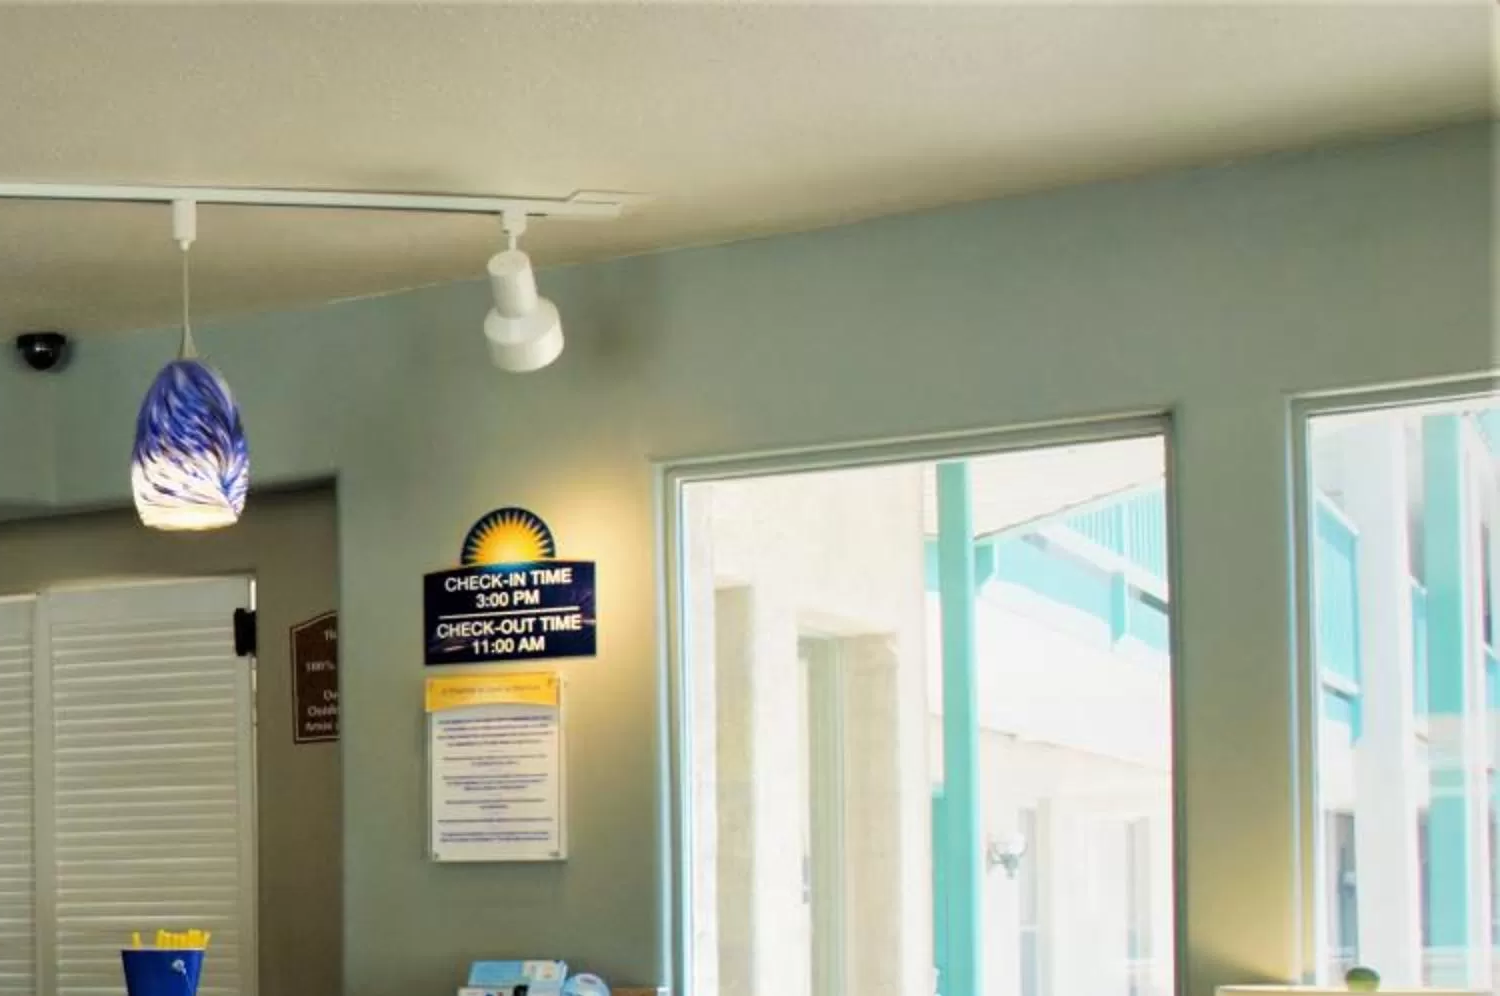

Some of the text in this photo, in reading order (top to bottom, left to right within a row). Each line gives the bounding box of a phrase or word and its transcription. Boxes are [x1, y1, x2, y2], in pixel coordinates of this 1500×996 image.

[444, 568, 573, 592] CHECK-IN TIME
[475, 590, 541, 609] 3:00 PM
[436, 614, 582, 639] CHECK-OUT TIME
[472, 636, 546, 655] 11:00 AM
